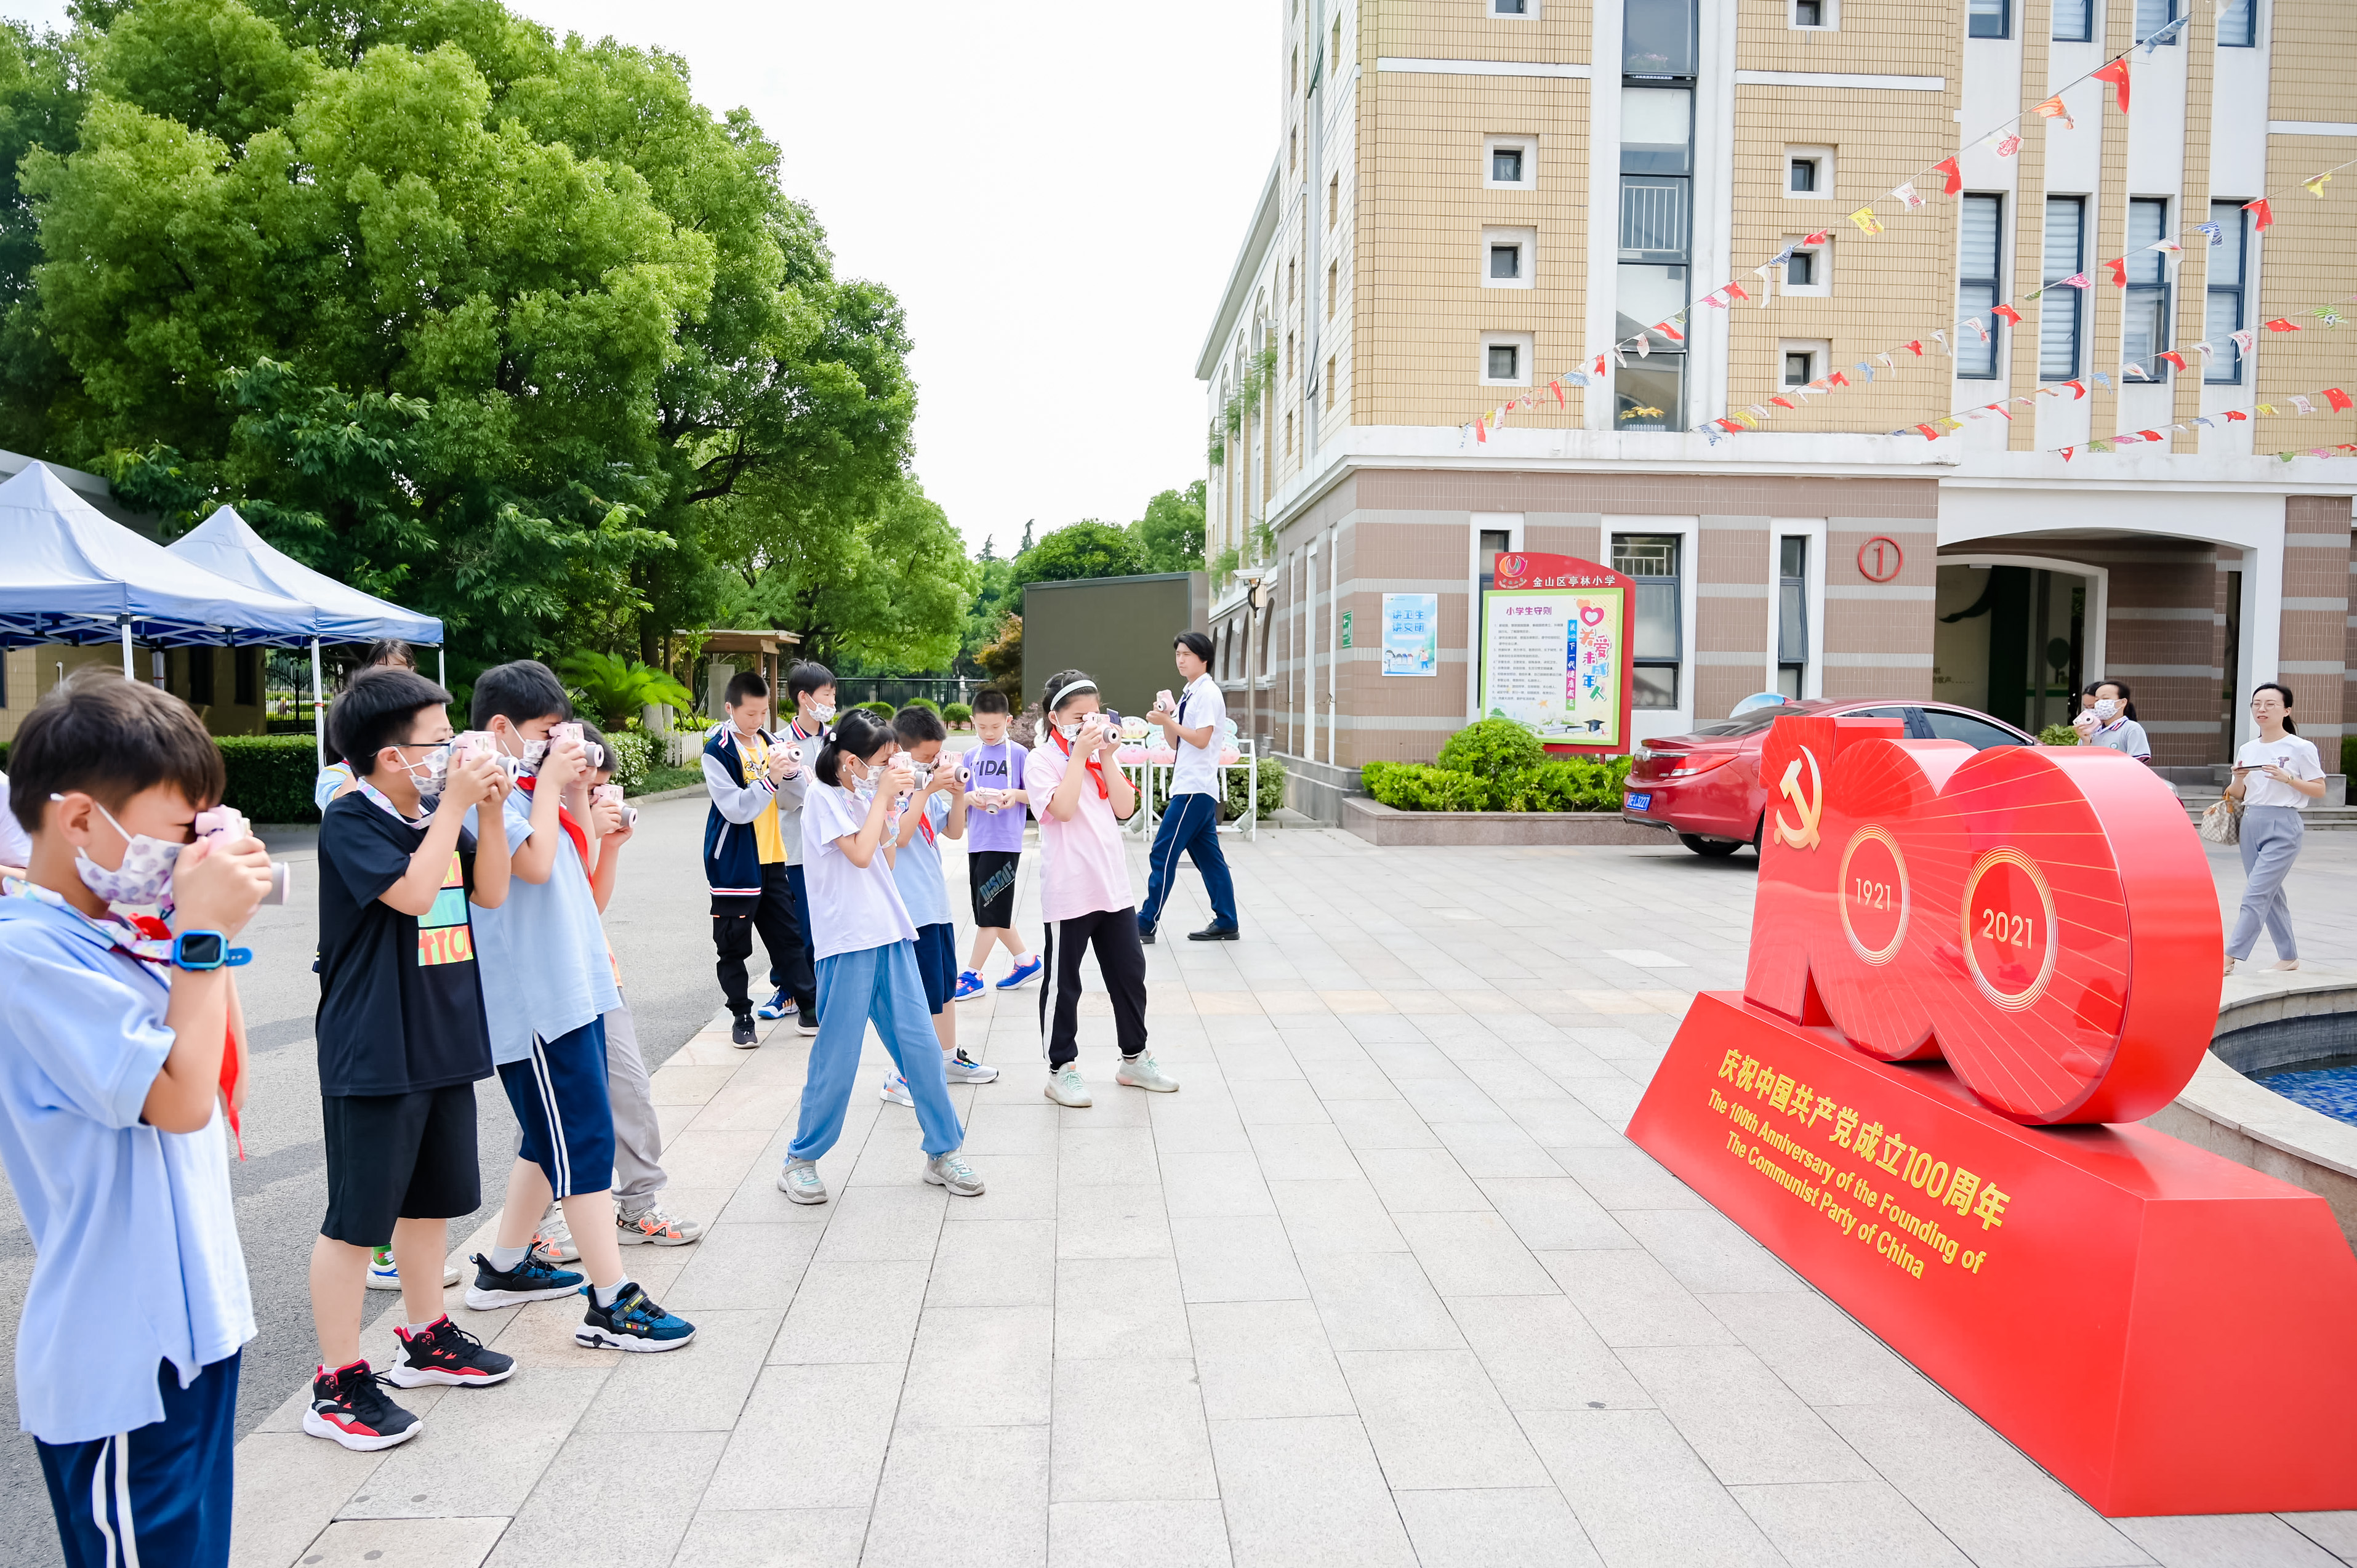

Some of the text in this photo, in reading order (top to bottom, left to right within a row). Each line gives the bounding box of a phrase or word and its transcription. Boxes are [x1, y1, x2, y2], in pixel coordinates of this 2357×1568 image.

[1533, 575, 1615, 587] 金山区亭林小学
[1392, 609, 1424, 619] 讲卫生
[1392, 622, 1424, 632] 讲文明
[1506, 606, 1552, 615] 小学生守则
[1856, 878, 1890, 911] 1921
[1983, 908, 2033, 949] 2021
[1718, 1049, 2011, 1231] 庆祝中国共产党成立100周年
[1708, 1088, 1987, 1274] The 100th Anniversary of the Founding of
[1726, 1130, 1925, 1279] The Communist Party of China
